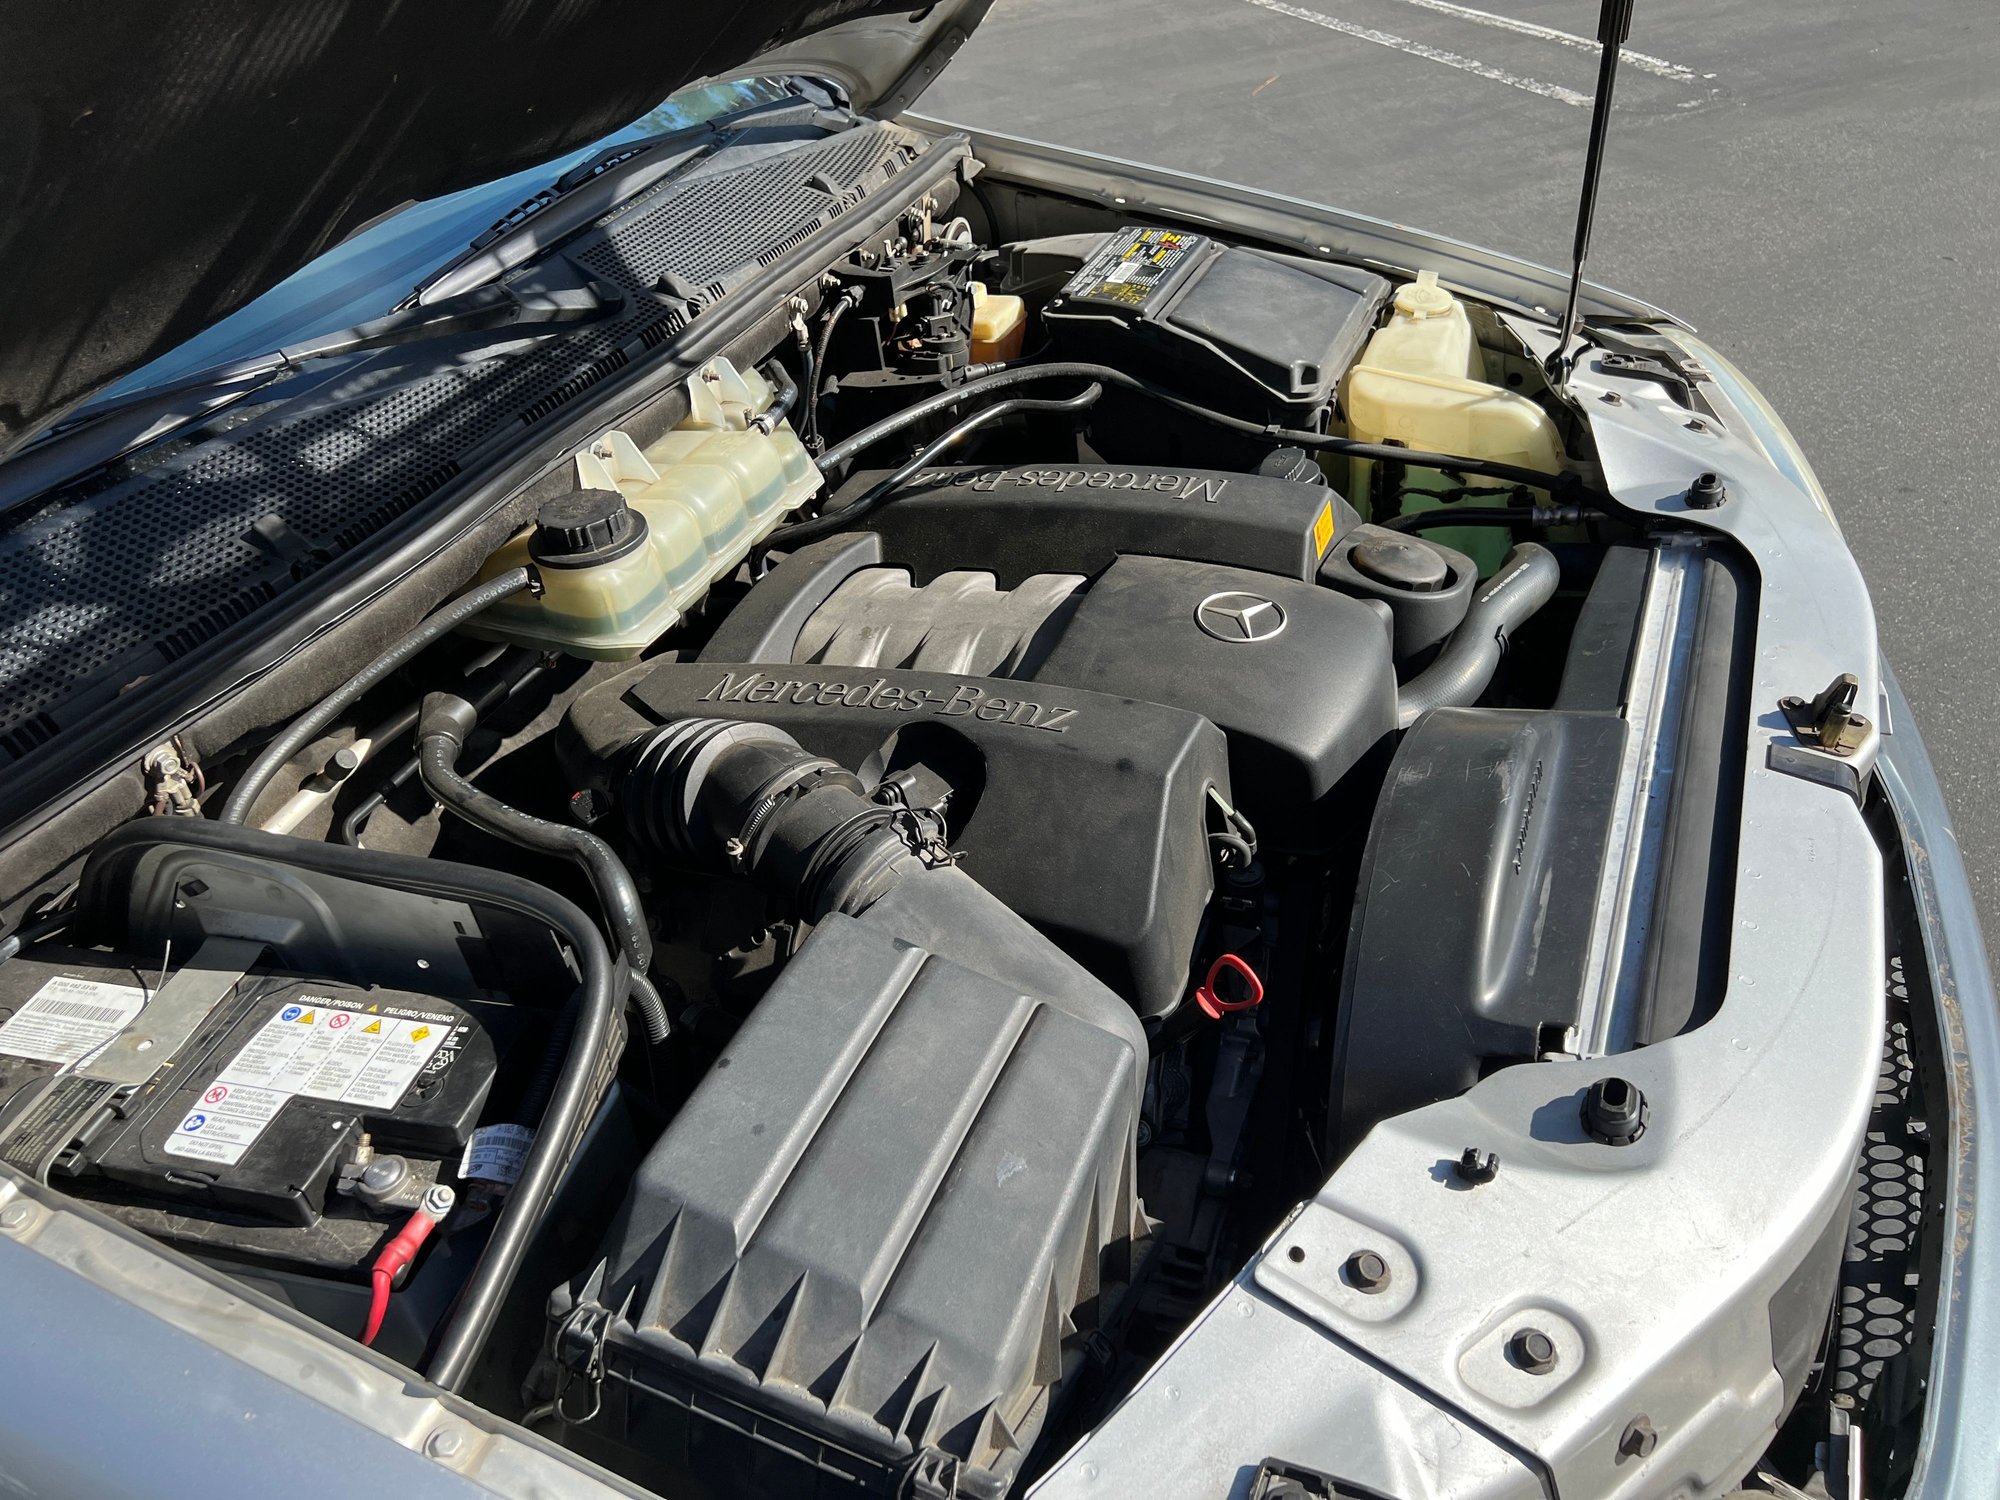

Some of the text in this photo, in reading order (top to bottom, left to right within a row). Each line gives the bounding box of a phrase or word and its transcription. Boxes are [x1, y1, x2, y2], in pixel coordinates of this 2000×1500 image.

[904, 467, 1232, 504] Mercedes-Benz
[699, 671, 1079, 733] Mercedes-Benz
[298, 994, 364, 1010] DANGER/POISON
[383, 1006, 455, 1023] PELIGRO/VENENO
